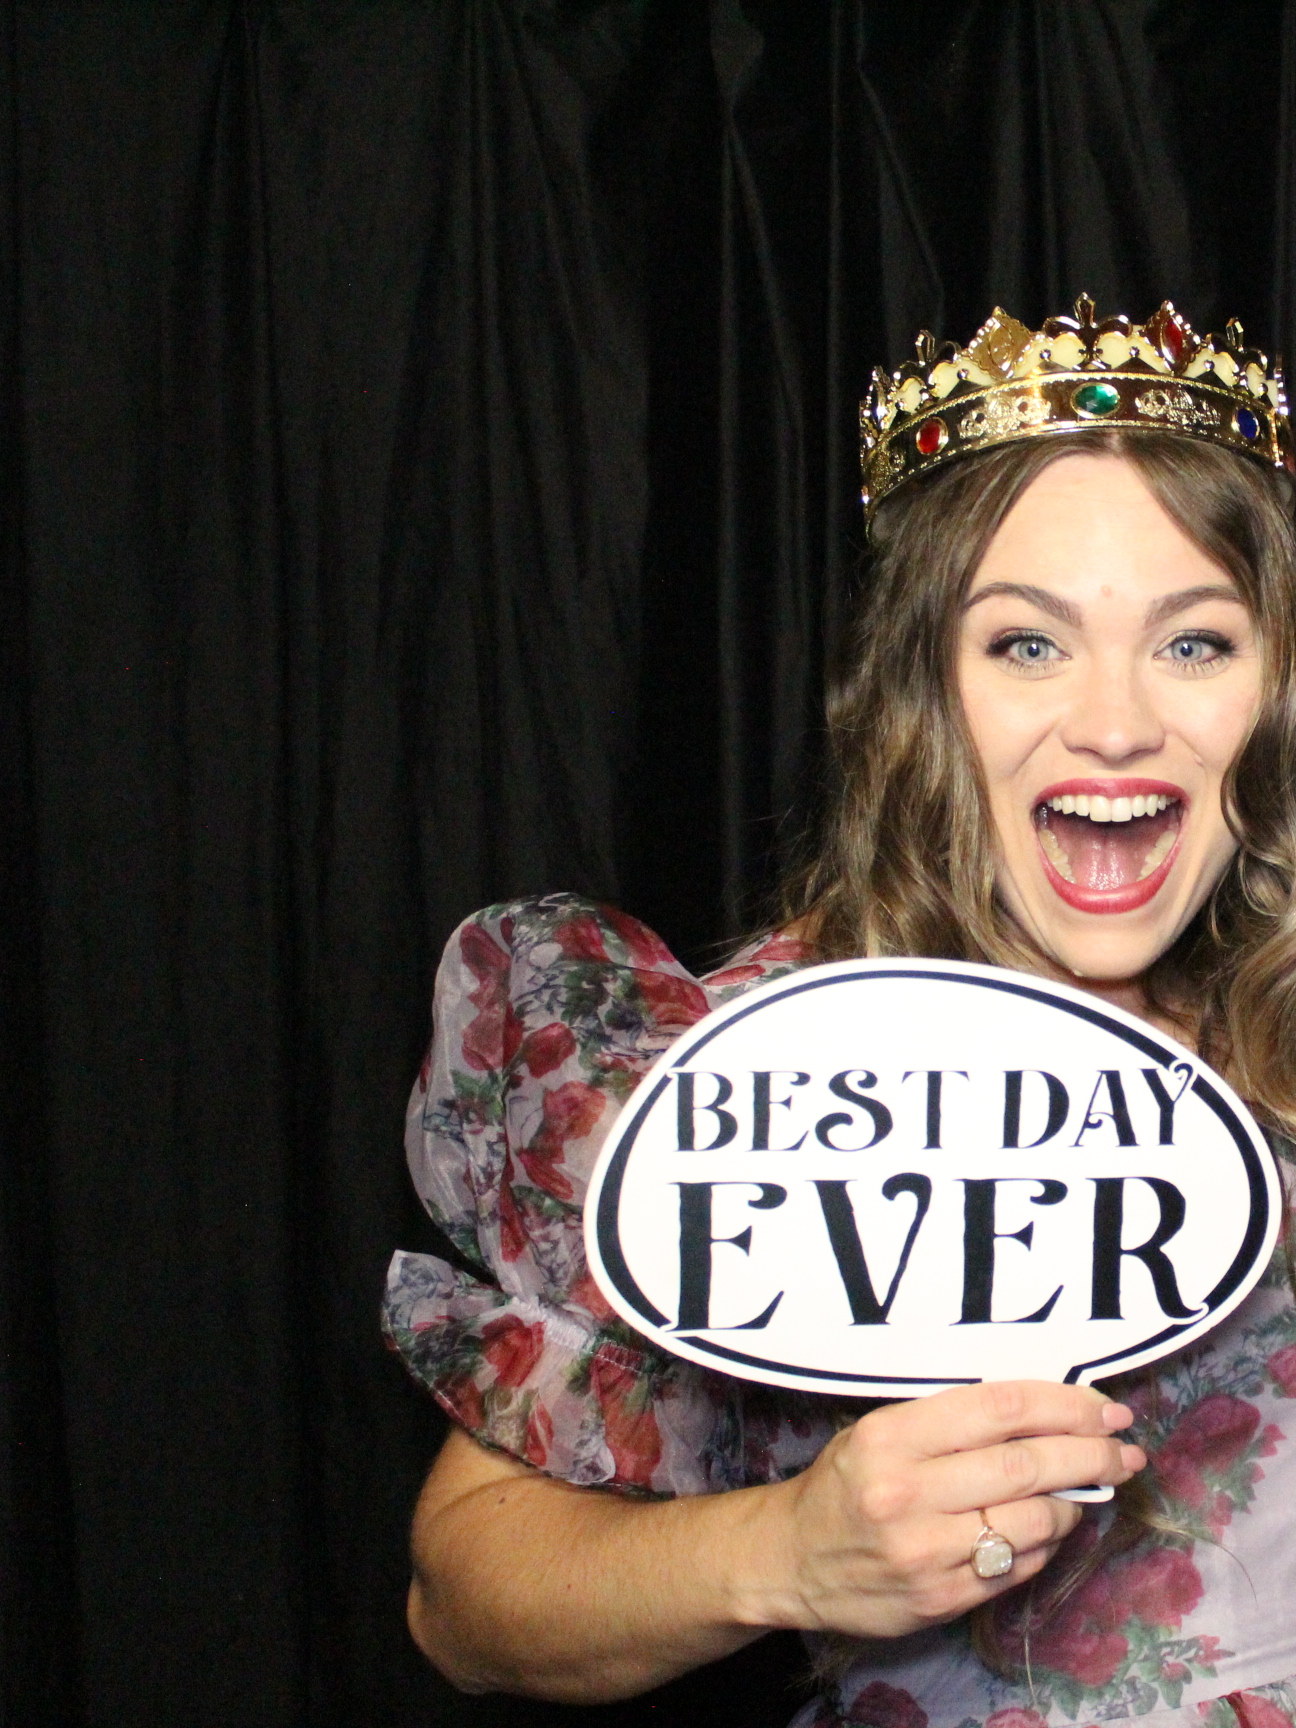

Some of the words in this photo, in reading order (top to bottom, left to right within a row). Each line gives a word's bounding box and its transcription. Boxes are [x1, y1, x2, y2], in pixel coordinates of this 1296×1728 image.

[670, 1070, 969, 1151] BEST
[1000, 1063, 1193, 1148] DAY
[669, 1173, 1203, 1332] EVER
